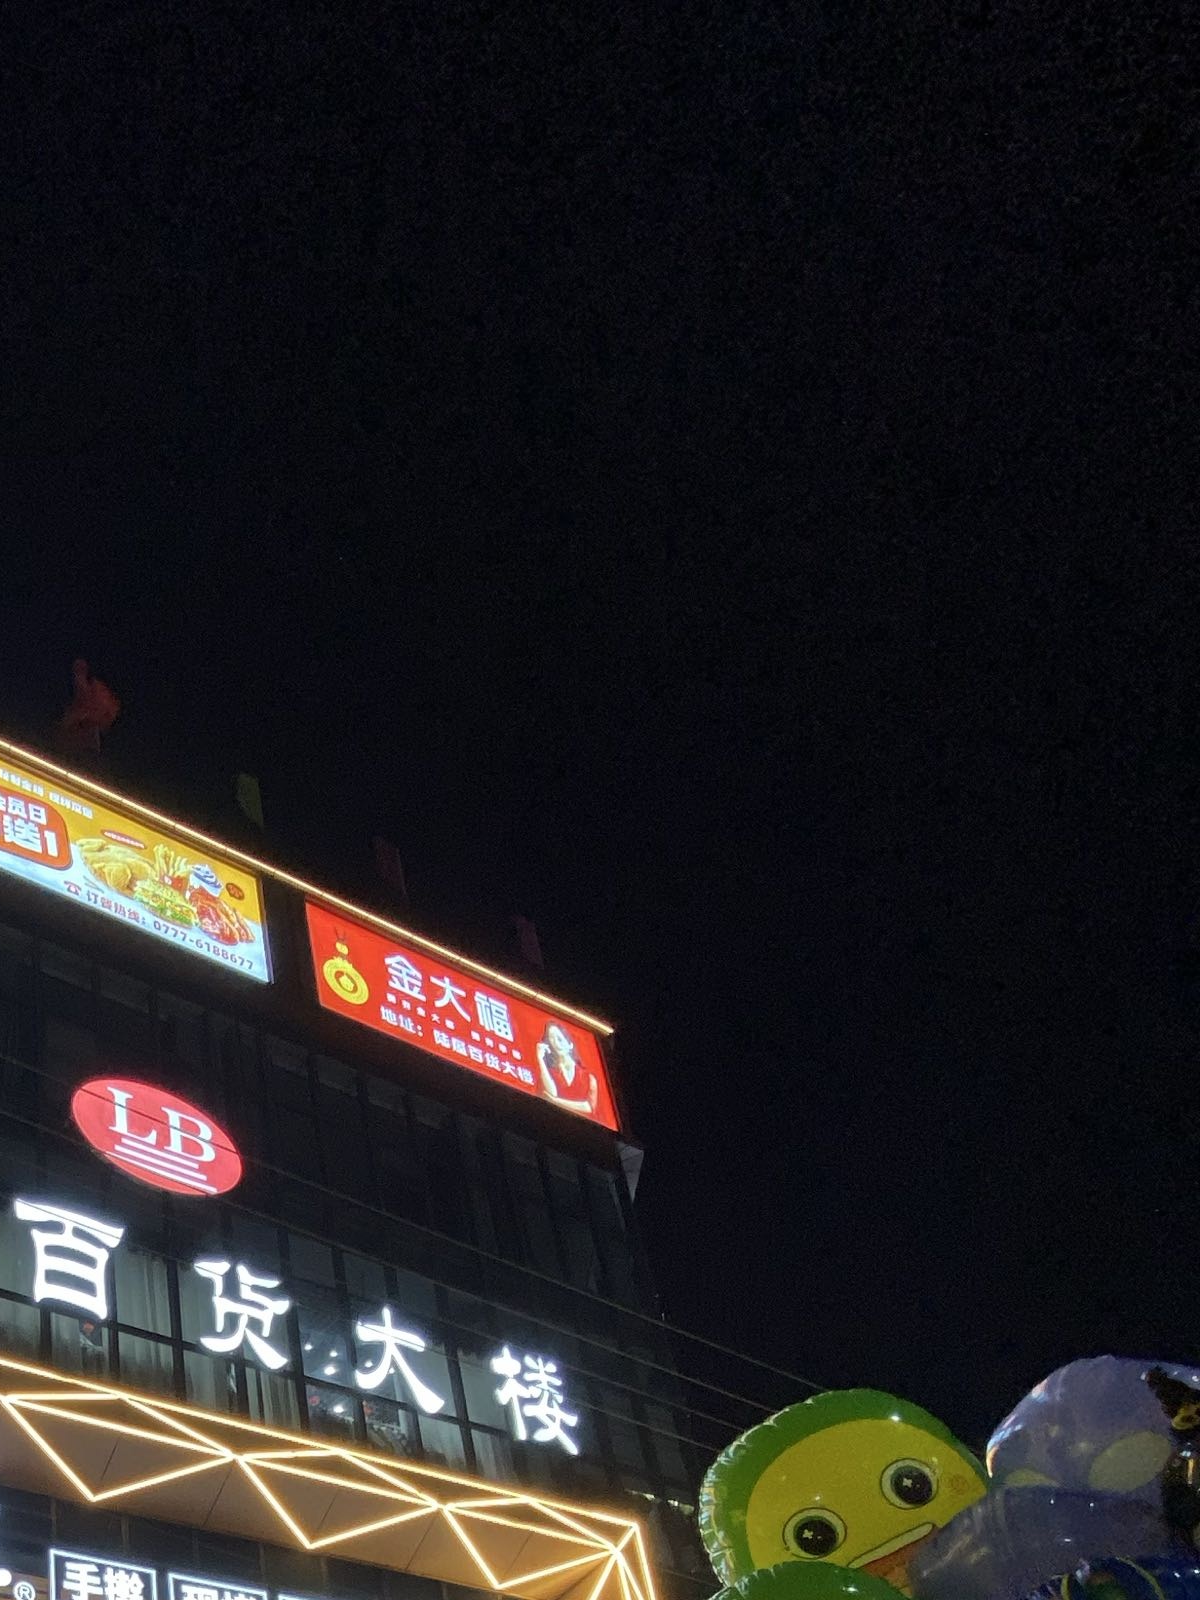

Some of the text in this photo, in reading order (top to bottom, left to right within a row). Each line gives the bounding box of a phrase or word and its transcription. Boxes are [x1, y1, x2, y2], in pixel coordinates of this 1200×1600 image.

[153, 920, 255, 970] 0777-6188677
[384, 954, 515, 1042] 金大福
[106, 1086, 218, 1162] LB
